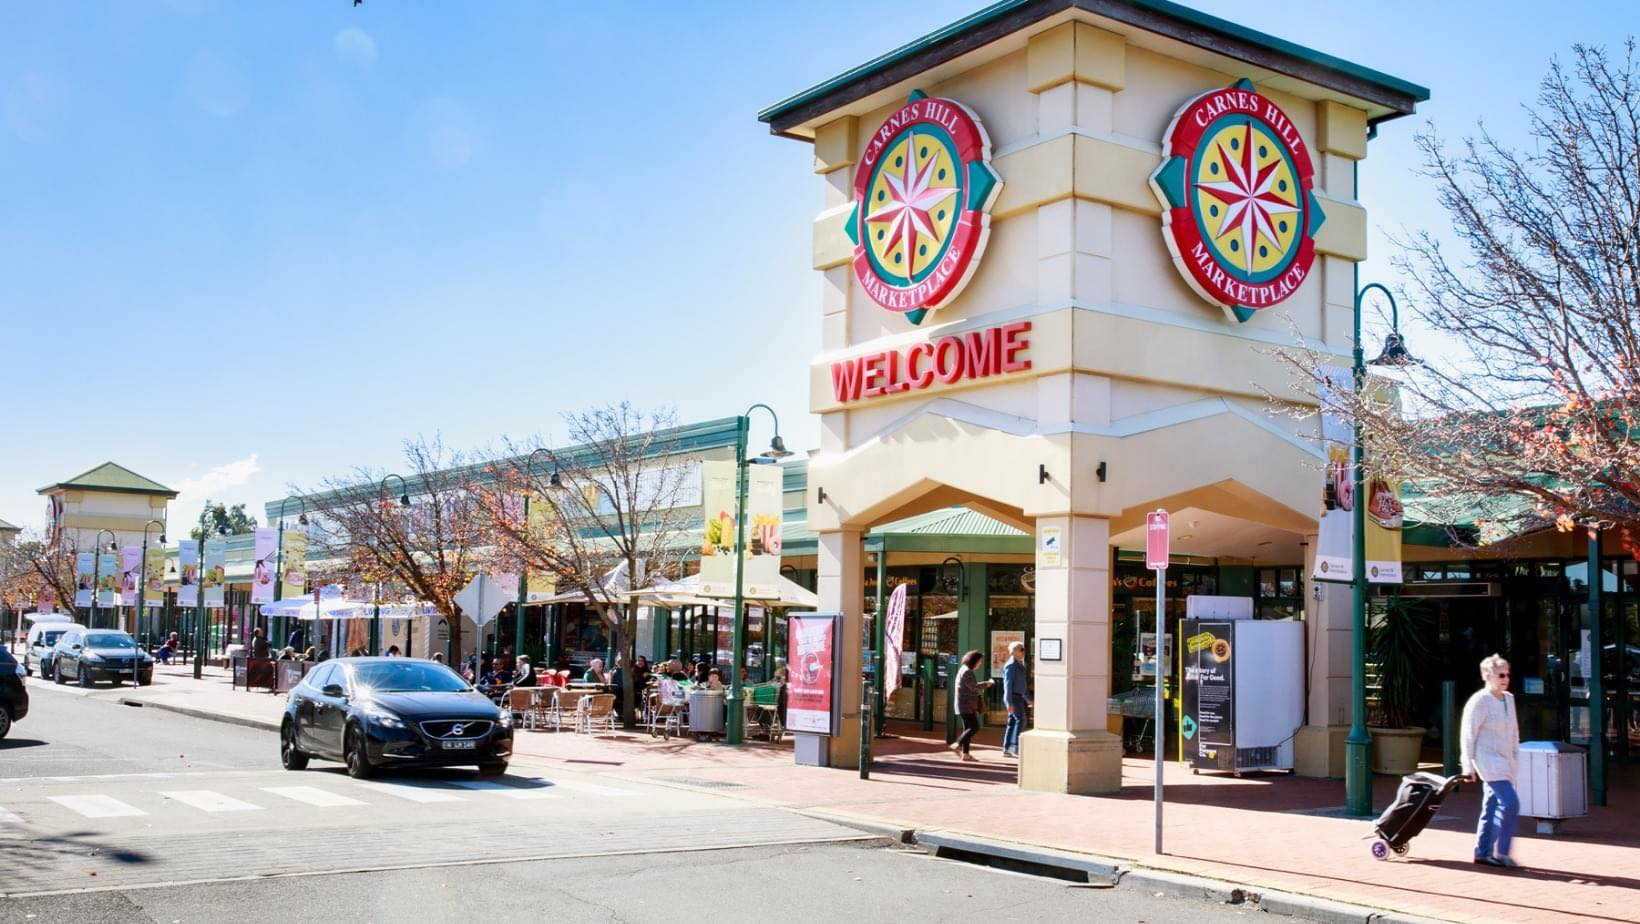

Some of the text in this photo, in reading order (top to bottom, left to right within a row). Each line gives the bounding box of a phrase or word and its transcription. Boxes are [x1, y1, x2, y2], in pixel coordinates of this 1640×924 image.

[864, 101, 959, 166] CARNES HILL
[1195, 92, 1300, 155] CARNES HILL
[861, 244, 961, 308] MARKETPLACE
[1192, 242, 1305, 304] MARKETPLACE
[831, 320, 1032, 403] WELCOME
[1139, 577, 1178, 588] Cofes
